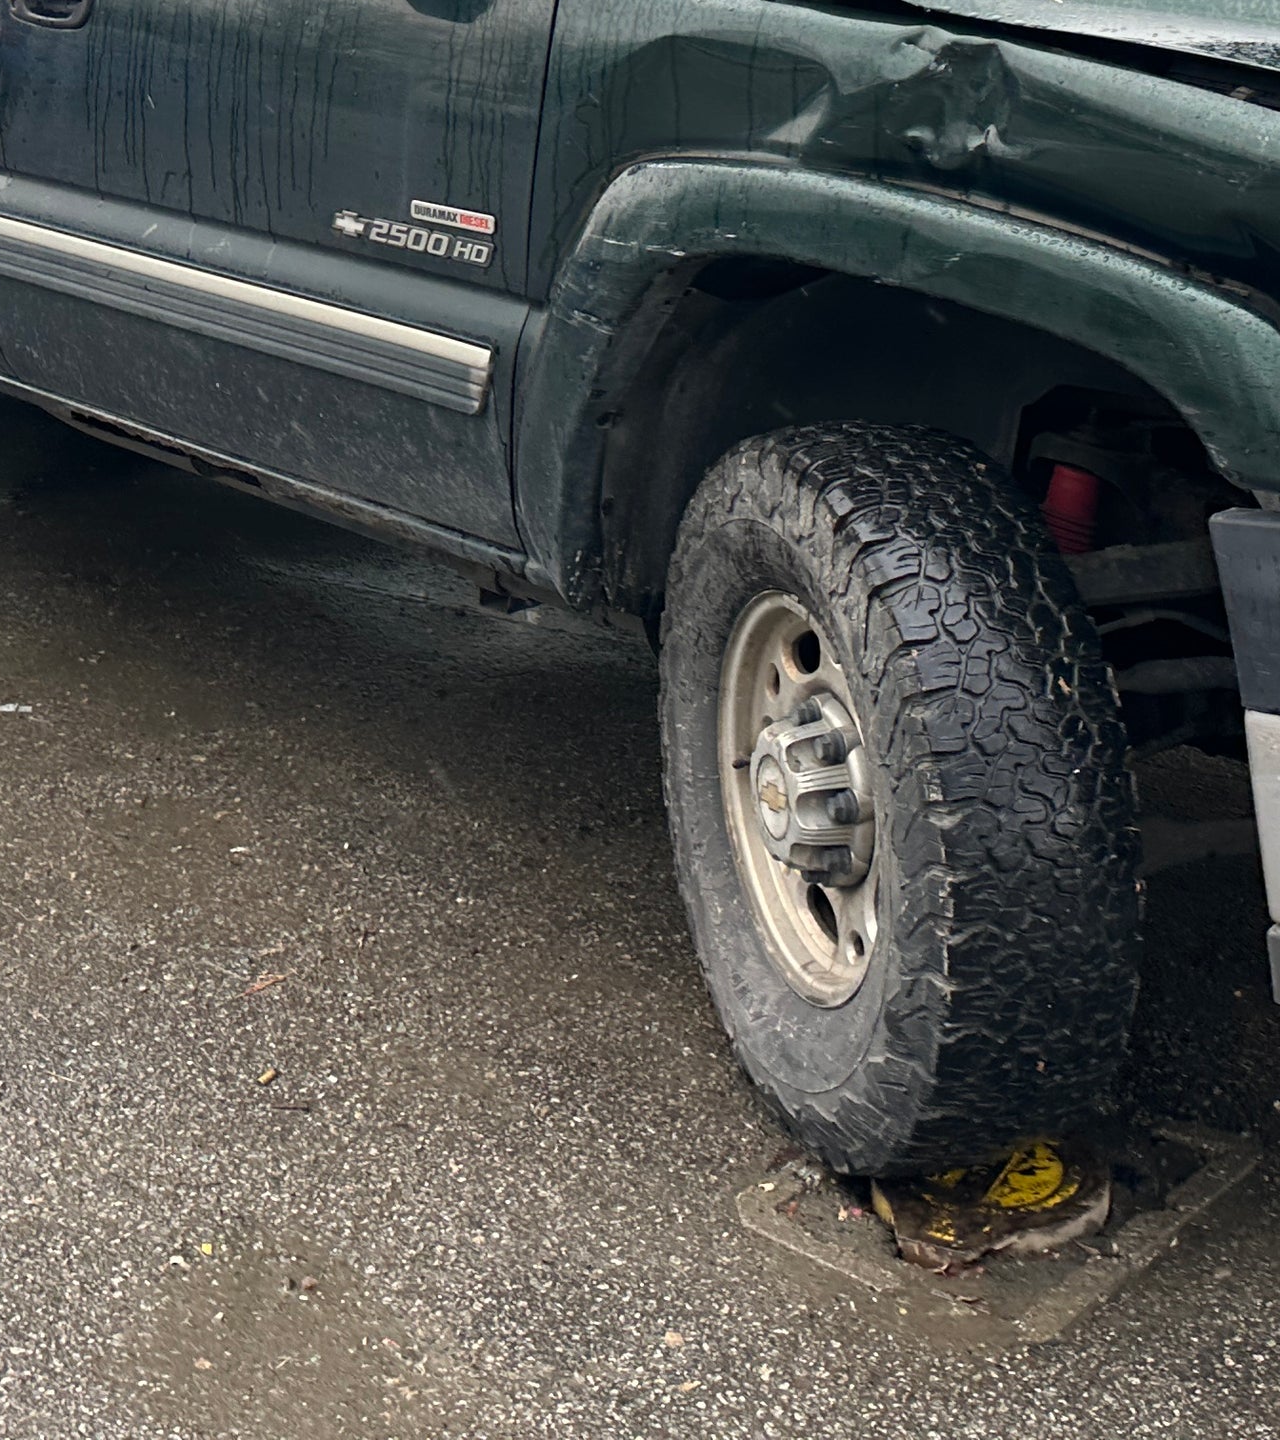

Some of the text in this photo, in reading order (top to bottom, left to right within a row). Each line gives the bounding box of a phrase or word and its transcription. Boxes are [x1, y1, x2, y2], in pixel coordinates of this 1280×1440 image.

[414, 204, 491, 230] DURAMAX DIESEL
[369, 219, 490, 264] 2500 HD
